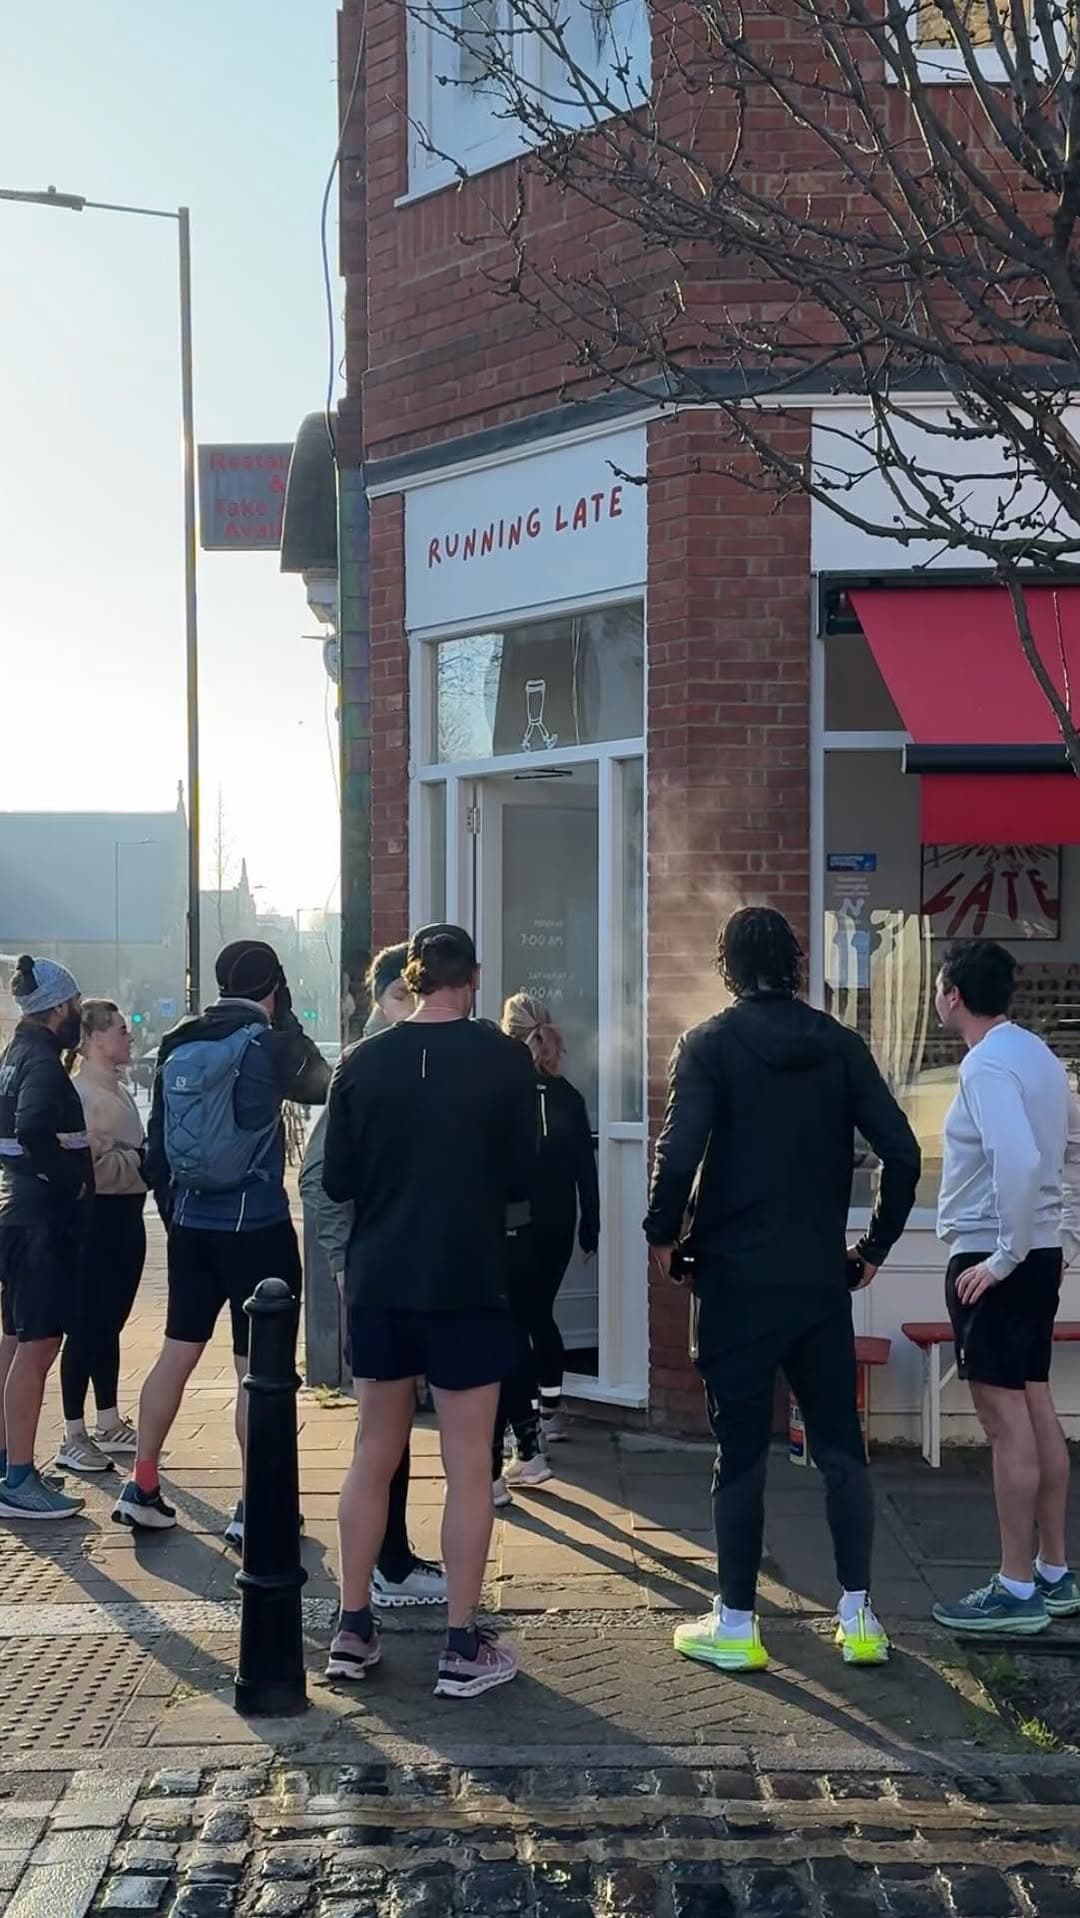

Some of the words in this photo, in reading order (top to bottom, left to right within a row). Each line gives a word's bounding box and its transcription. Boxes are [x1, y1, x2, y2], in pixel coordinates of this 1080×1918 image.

[428, 507, 541, 569] RUNNING
[556, 485, 623, 532] LATE
[921, 867, 1059, 937] LATE
